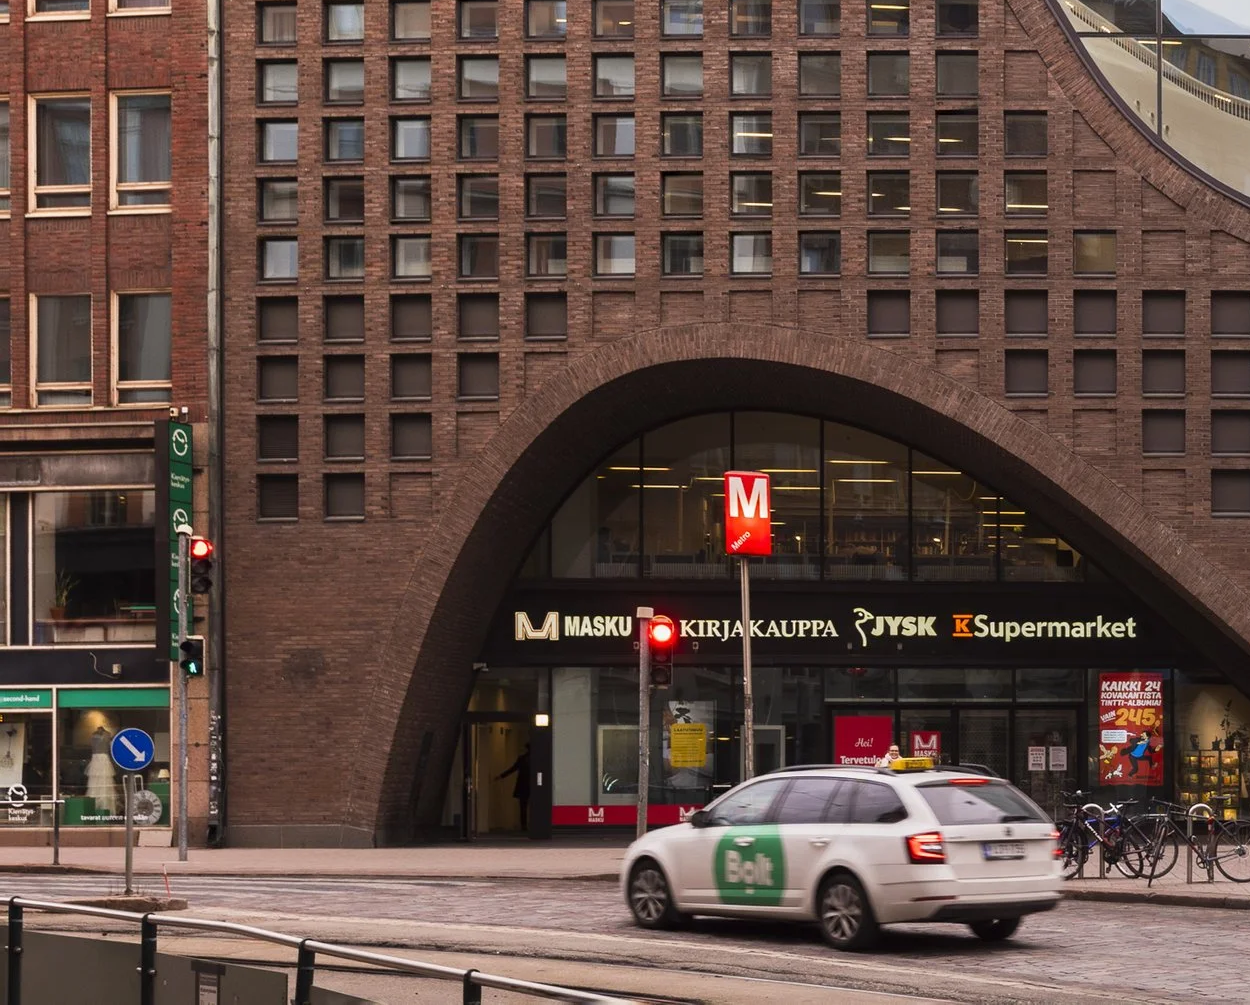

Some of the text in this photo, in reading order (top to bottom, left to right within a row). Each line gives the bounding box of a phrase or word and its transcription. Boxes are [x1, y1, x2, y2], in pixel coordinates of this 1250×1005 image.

[729, 477, 768, 518] M
[731, 531, 751, 551] Metro
[564, 616, 633, 637] MASKU
[679, 619, 839, 638] KIRJAKAUPPA
[871, 616, 938, 637] JYSK
[974, 614, 1137, 642] Supermarket
[1102, 681, 1161, 692] KAIKKI 24
[3, 694, 40, 702] second-hand
[1101, 691, 1162, 699] KOVAKANTISTA
[1101, 699, 1162, 707] TINTTI-ALBUMIA!
[1101, 710, 1116, 722] VAIN
[854, 738, 874, 747] Hei!
[840, 755, 882, 765] Tervetulo
[725, 850, 774, 887] Bolt
